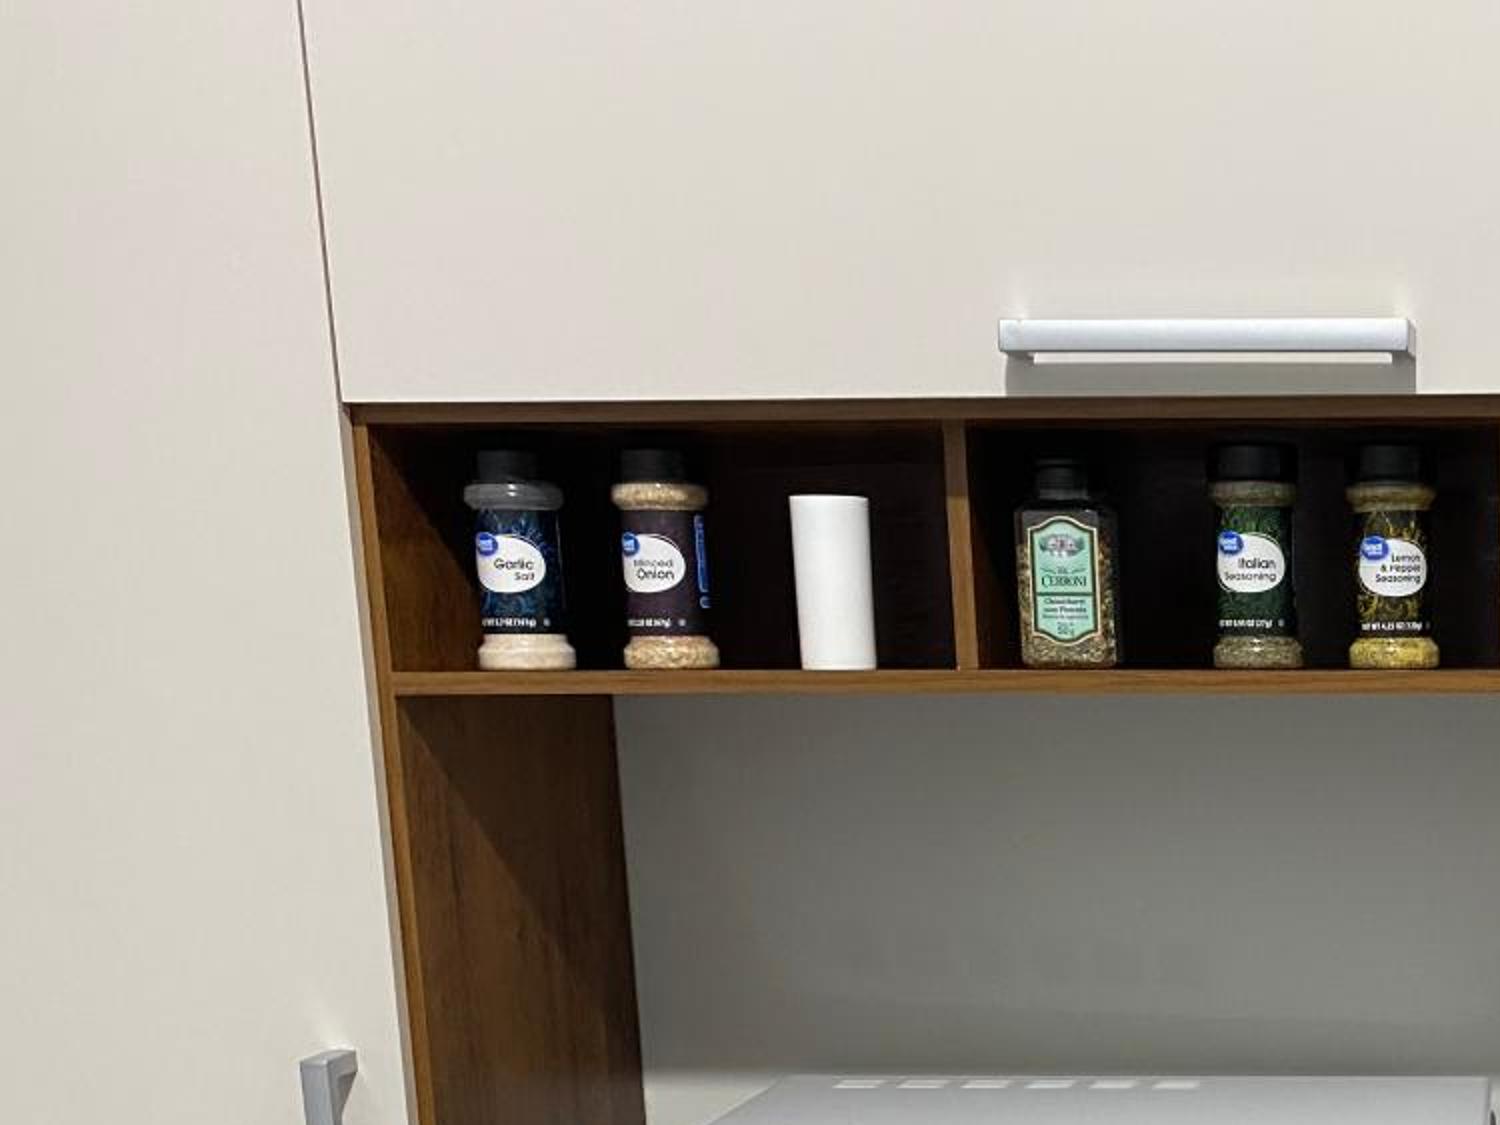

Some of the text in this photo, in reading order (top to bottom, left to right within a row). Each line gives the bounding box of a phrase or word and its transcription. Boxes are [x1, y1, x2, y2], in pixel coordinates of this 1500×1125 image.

[493, 558, 534, 571] Garlic
[1237, 557, 1277, 569] Italian
[513, 571, 535, 581] Salt
[635, 568, 675, 581] Onion
[1225, 570, 1277, 583] Seasoning
[1374, 573, 1421, 584] Seasoning
